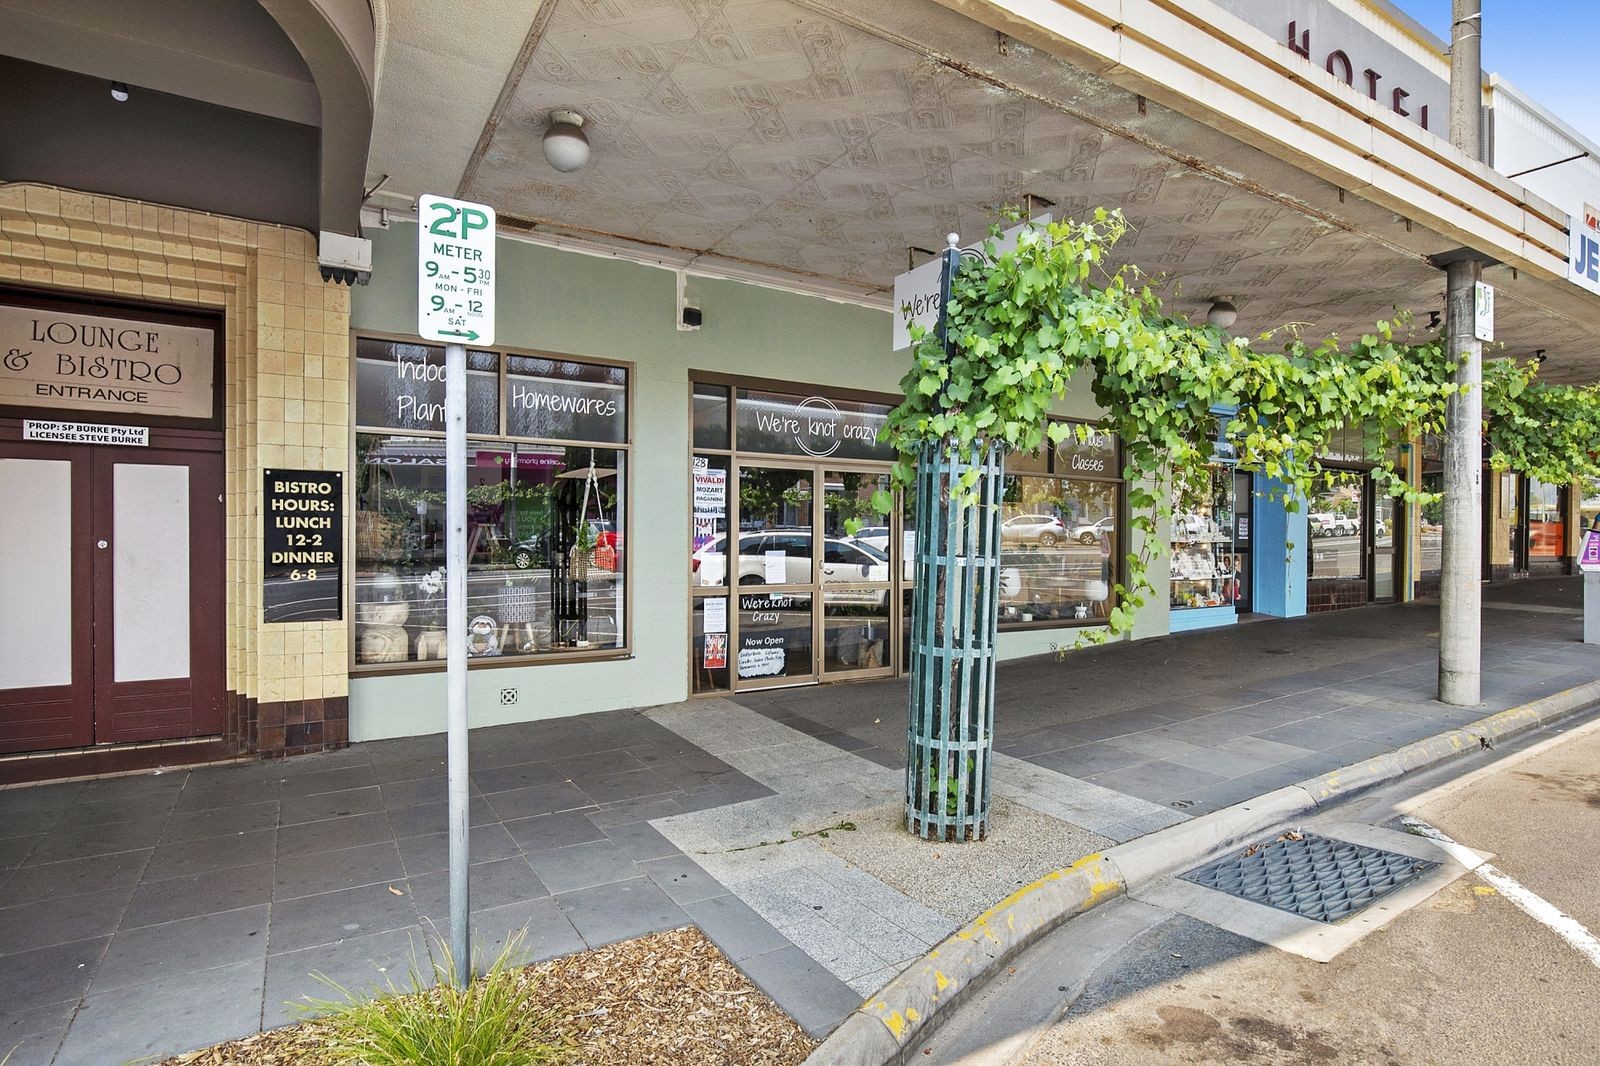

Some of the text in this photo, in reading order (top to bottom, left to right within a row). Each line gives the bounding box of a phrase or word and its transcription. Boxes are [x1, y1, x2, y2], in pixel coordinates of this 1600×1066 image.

[429, 203, 489, 240] 2P
[433, 242, 483, 262] METER
[435, 283, 458, 293] MON
[467, 287, 483, 296] FRI
[448, 318, 467, 327] SAT
[31, 320, 159, 354] LOUNGE
[4, 349, 182, 385] & BISTRO
[397, 354, 447, 382] Indoo
[36, 384, 149, 403] ENTRANCE
[512, 385, 617, 417] Homewares
[397, 395, 447, 422] Plant
[29, 421, 144, 436] PROP: SP BURKE Pty Ltd
[756, 411, 878, 447] We're knot crazy
[30, 431, 144, 444] LICENSEE STEVE BURKE
[1072, 454, 1104, 471] Classes
[695, 476, 725, 484] VIVALDI
[274, 481, 332, 494] BISTRO
[696, 486, 724, 494] MOZART
[271, 499, 335, 512] HOURS:
[276, 516, 331, 529] LUNCH
[286, 534, 323, 546] 12-2
[271, 552, 335, 564] DINNER
[290, 569, 317, 581] 6-8
[752, 611, 780, 624] Crazy
[745, 637, 784, 646] Now Open
